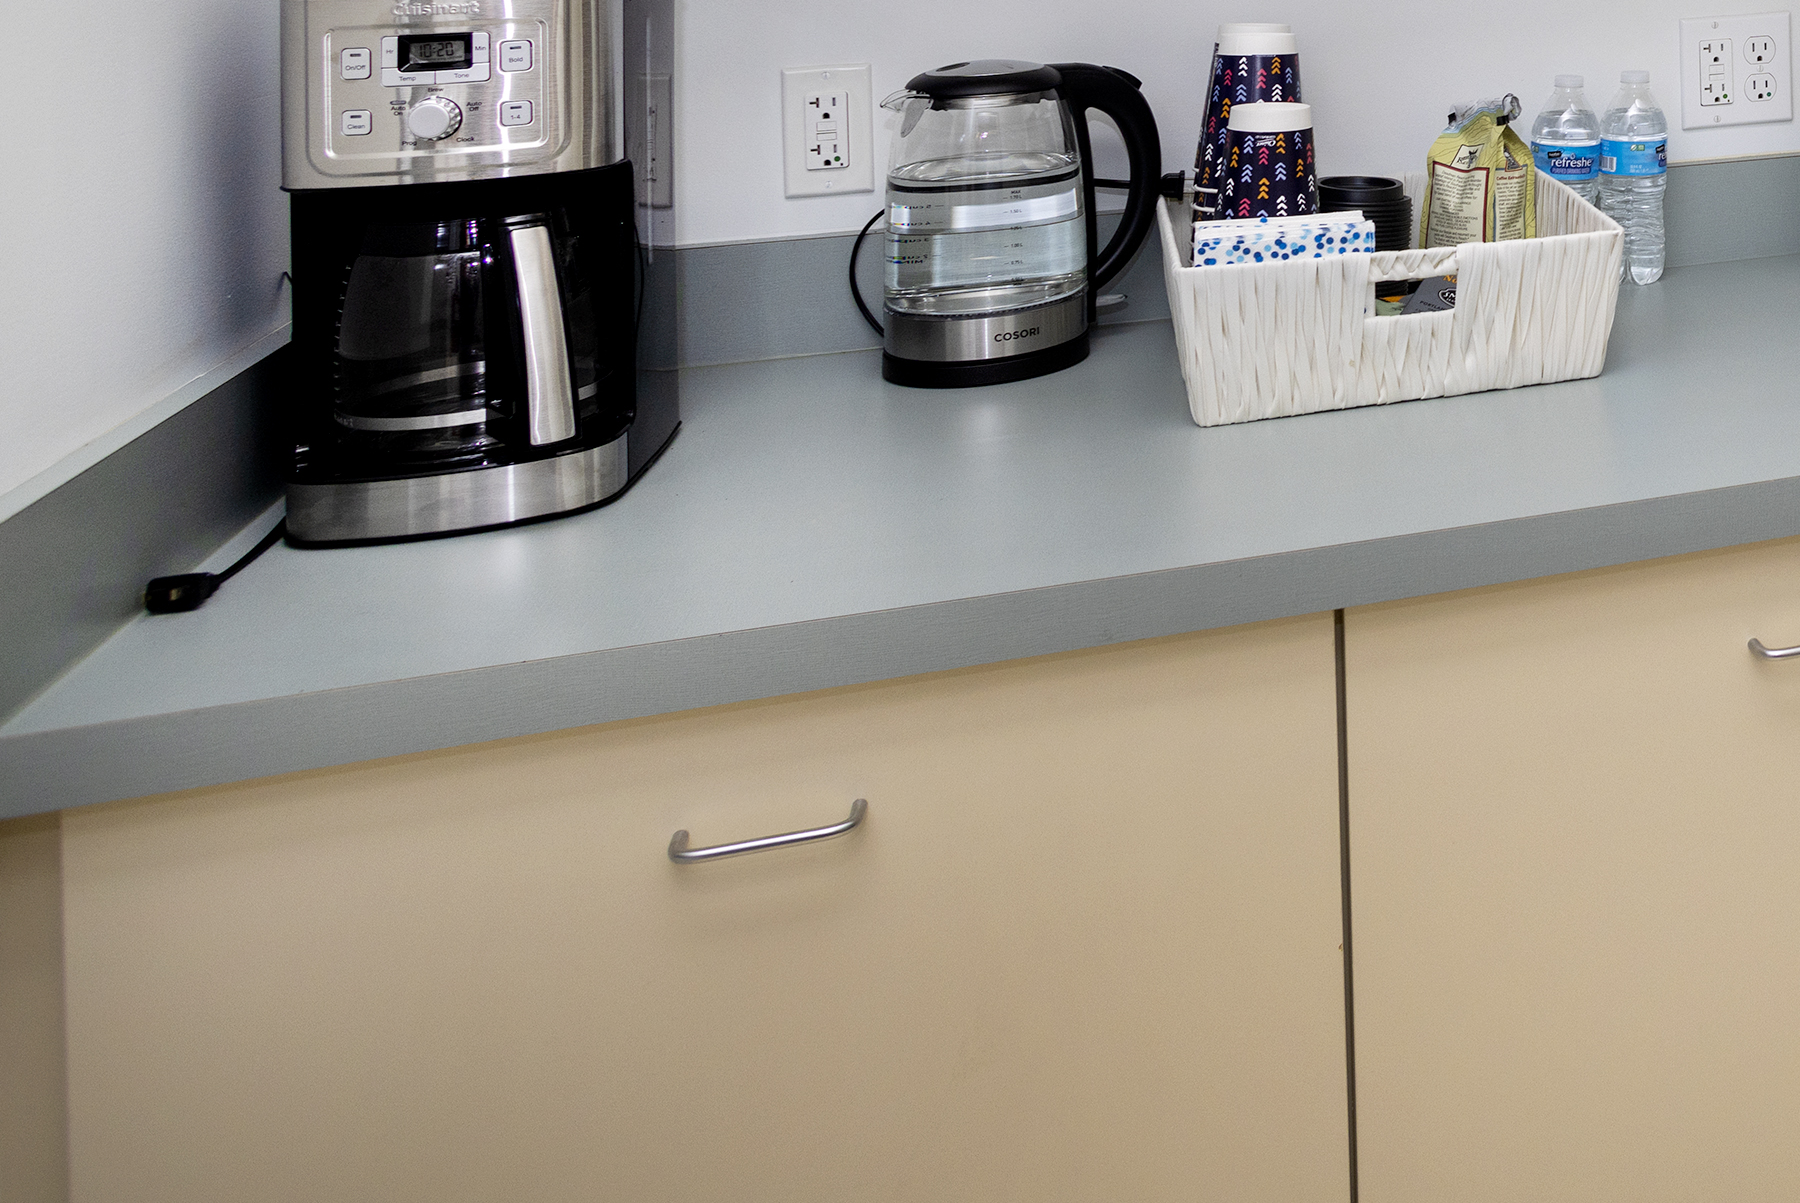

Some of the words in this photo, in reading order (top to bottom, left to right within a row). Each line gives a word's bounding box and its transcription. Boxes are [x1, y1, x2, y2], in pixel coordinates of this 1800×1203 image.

[393, 1, 480, 16] Cuisinart
[420, 42, 454, 58] 10:20
[1551, 157, 1592, 168] refreshe
[994, 327, 1040, 342] COSORI
